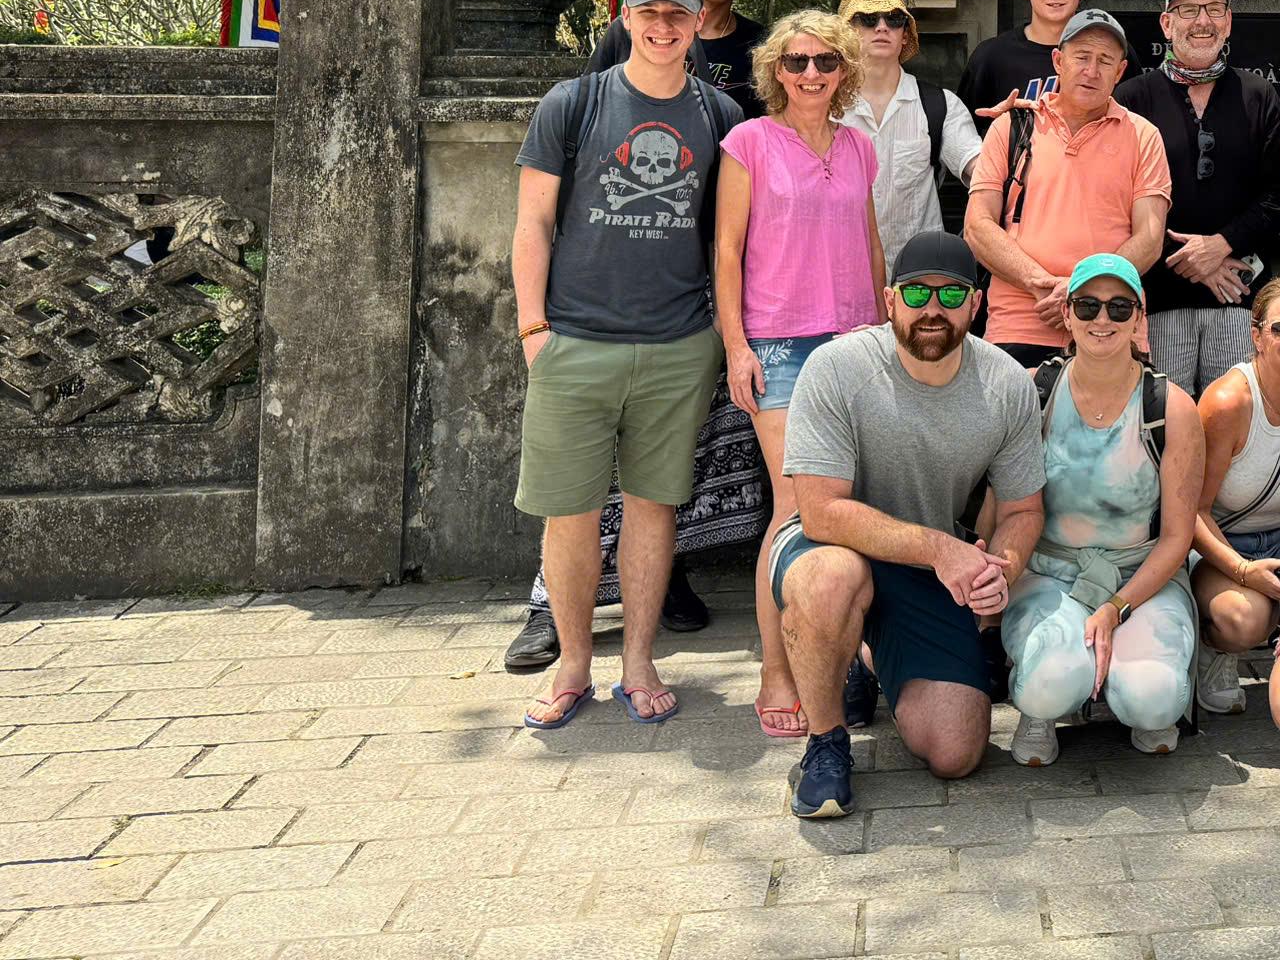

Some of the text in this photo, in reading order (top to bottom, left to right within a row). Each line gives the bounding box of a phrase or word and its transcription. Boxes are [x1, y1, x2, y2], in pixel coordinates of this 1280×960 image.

[605, 183, 626, 195] 96.7
[589, 208, 652, 227] PIRATE
[629, 229, 643, 239] KEY
[646, 229, 664, 240] WEST
